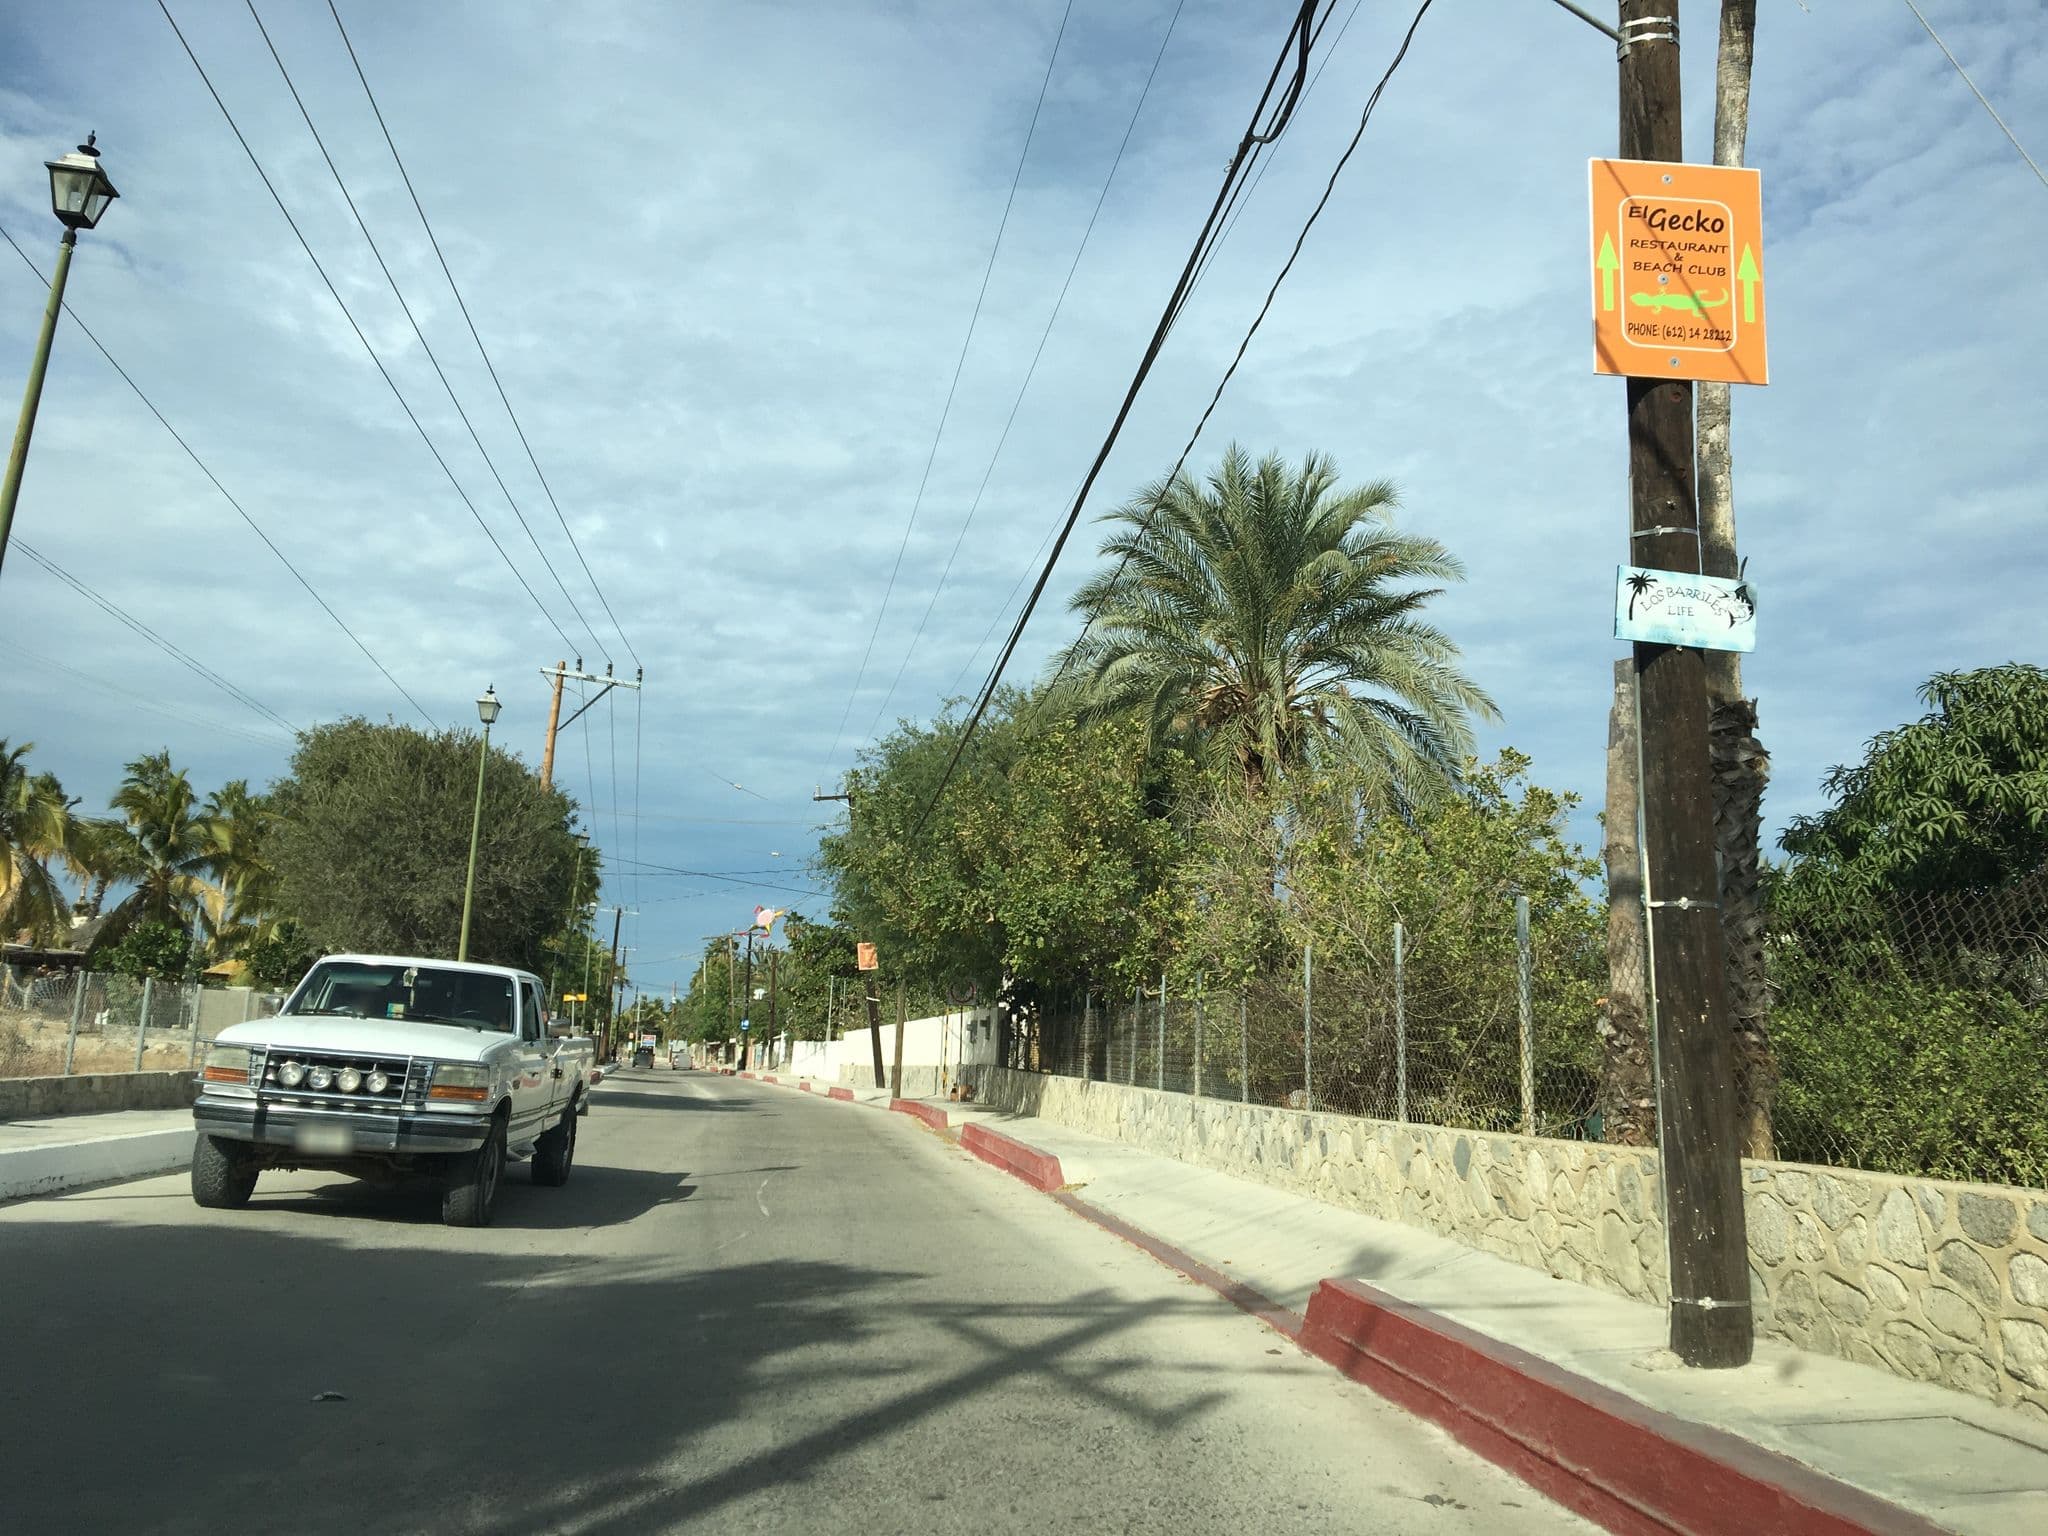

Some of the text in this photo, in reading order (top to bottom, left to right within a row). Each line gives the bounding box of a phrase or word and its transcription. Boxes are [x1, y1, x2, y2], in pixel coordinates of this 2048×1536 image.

[1628, 205, 1725, 233] El Gecko
[1630, 239, 1729, 255] RESTAURANT
[1673, 252, 1684, 262] &
[1633, 261, 1727, 277] BEACH CLUB
[1627, 322, 1733, 342] PHONE: (612) 14 28212
[1640, 586, 1726, 616] LOS BARRILES
[1667, 605, 1695, 617] LIFE
